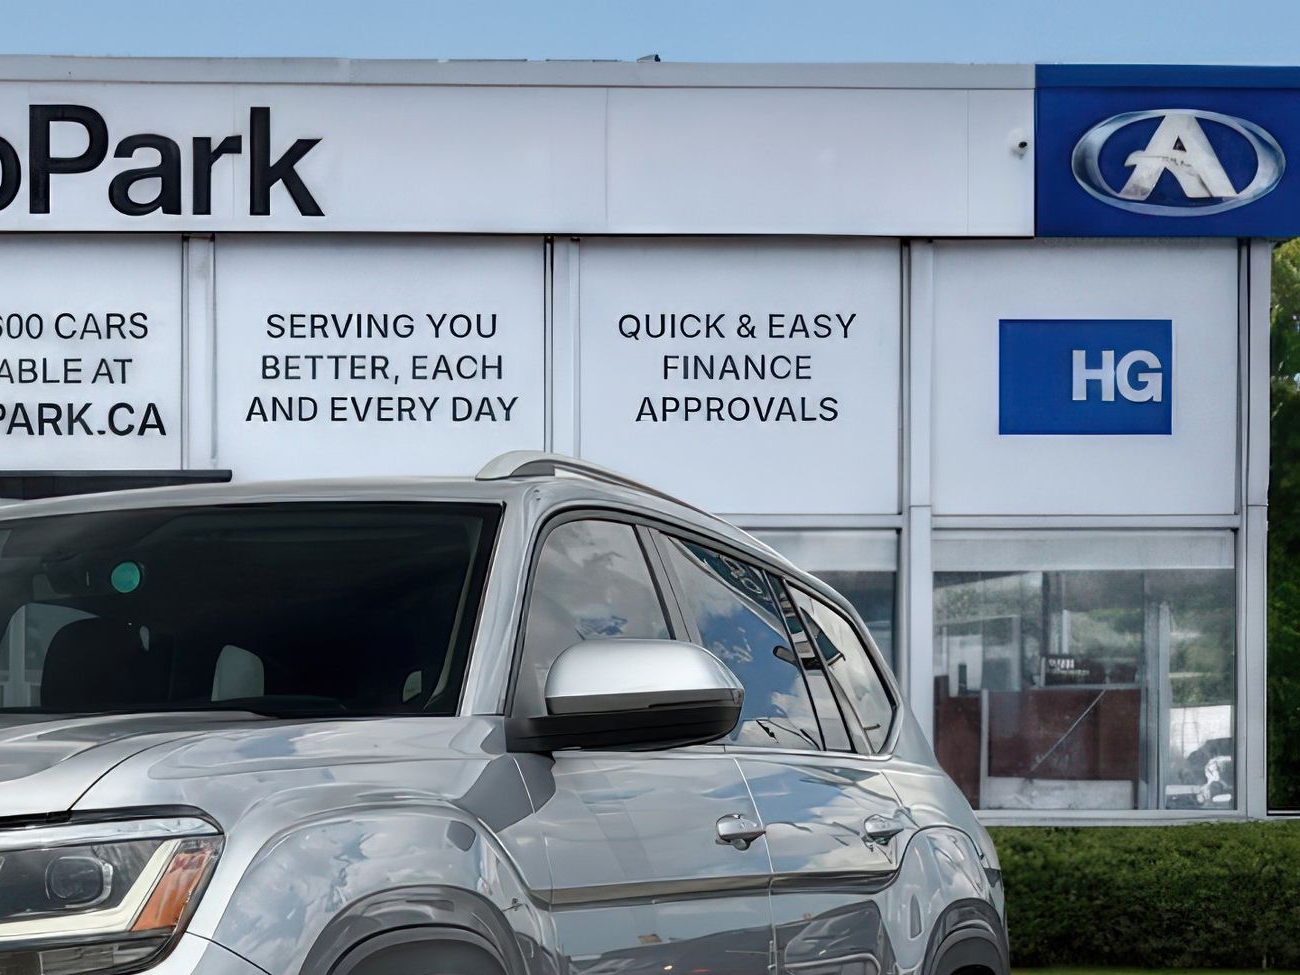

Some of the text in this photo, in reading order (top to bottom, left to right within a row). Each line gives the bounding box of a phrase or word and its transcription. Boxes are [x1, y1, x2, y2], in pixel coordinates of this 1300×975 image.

[54, 313, 150, 340] CARS
[266, 313, 498, 339] SERVING YOU
[618, 313, 857, 341] QUICK & EASY
[91, 358, 134, 385] AT
[261, 354, 503, 385] BETTER, EACH
[662, 354, 812, 381] FINANCE
[1071, 348, 1163, 403] HG
[245, 396, 519, 423] AND EVERY DAY
[635, 396, 840, 423] APPROVALS
